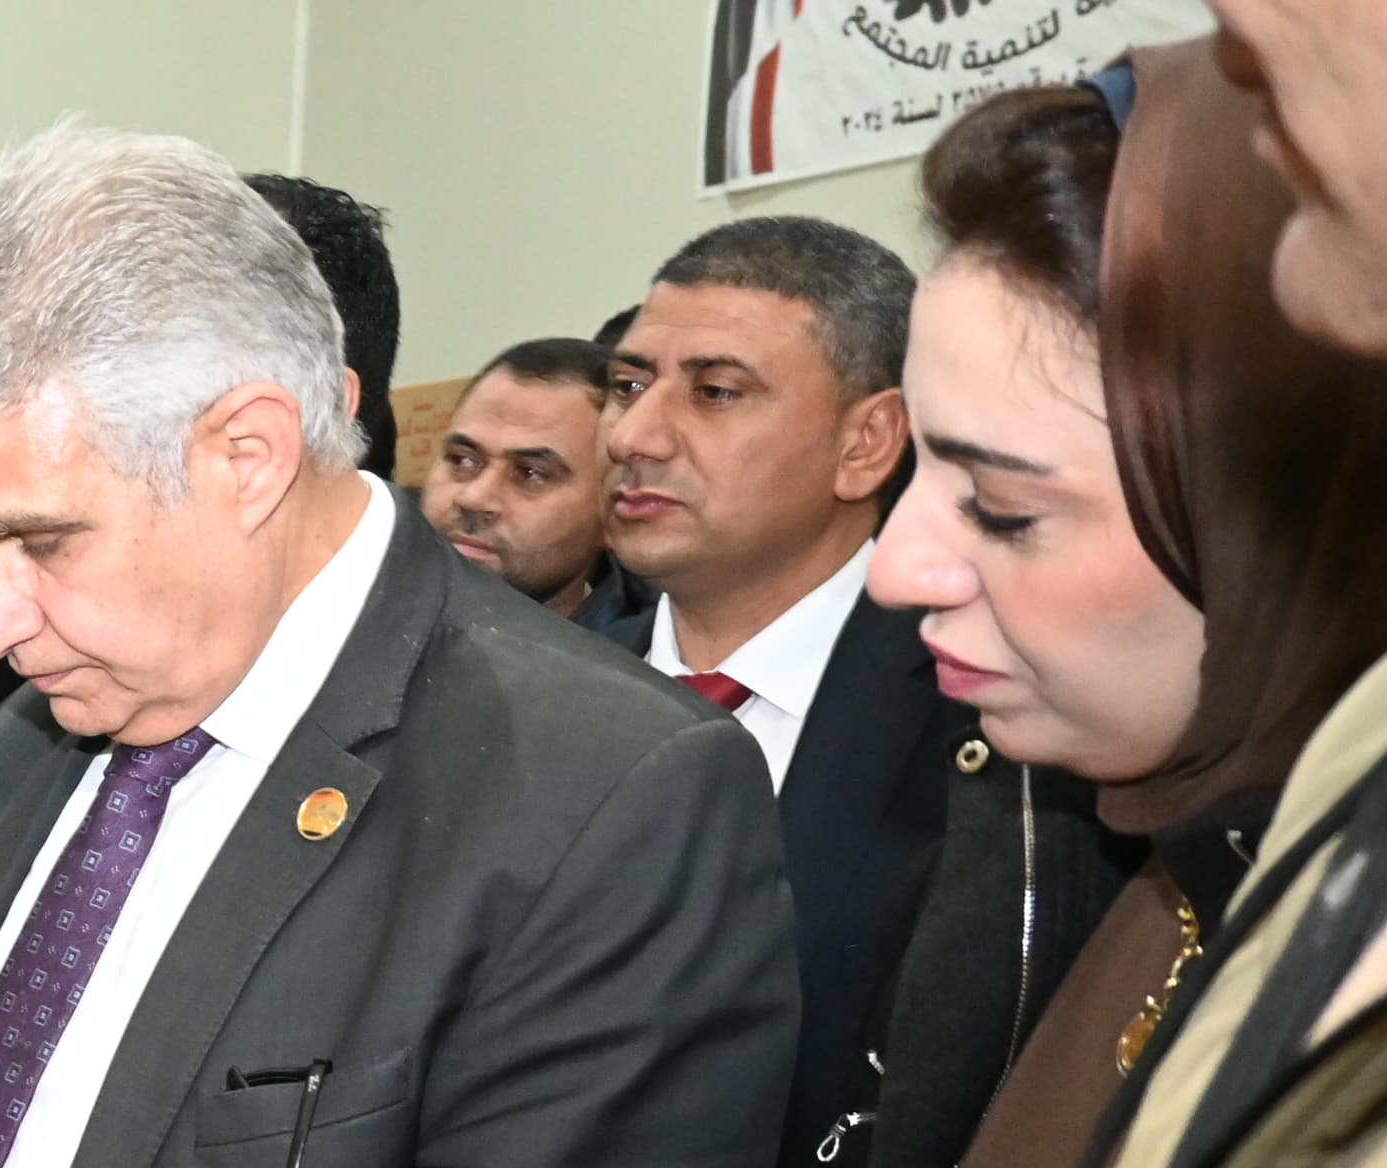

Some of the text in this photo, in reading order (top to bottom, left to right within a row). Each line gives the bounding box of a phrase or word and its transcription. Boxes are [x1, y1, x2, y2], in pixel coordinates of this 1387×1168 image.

[843, 4, 1061, 77] لتنمية المجتمع
[891, 94, 944, 125] لسنة
